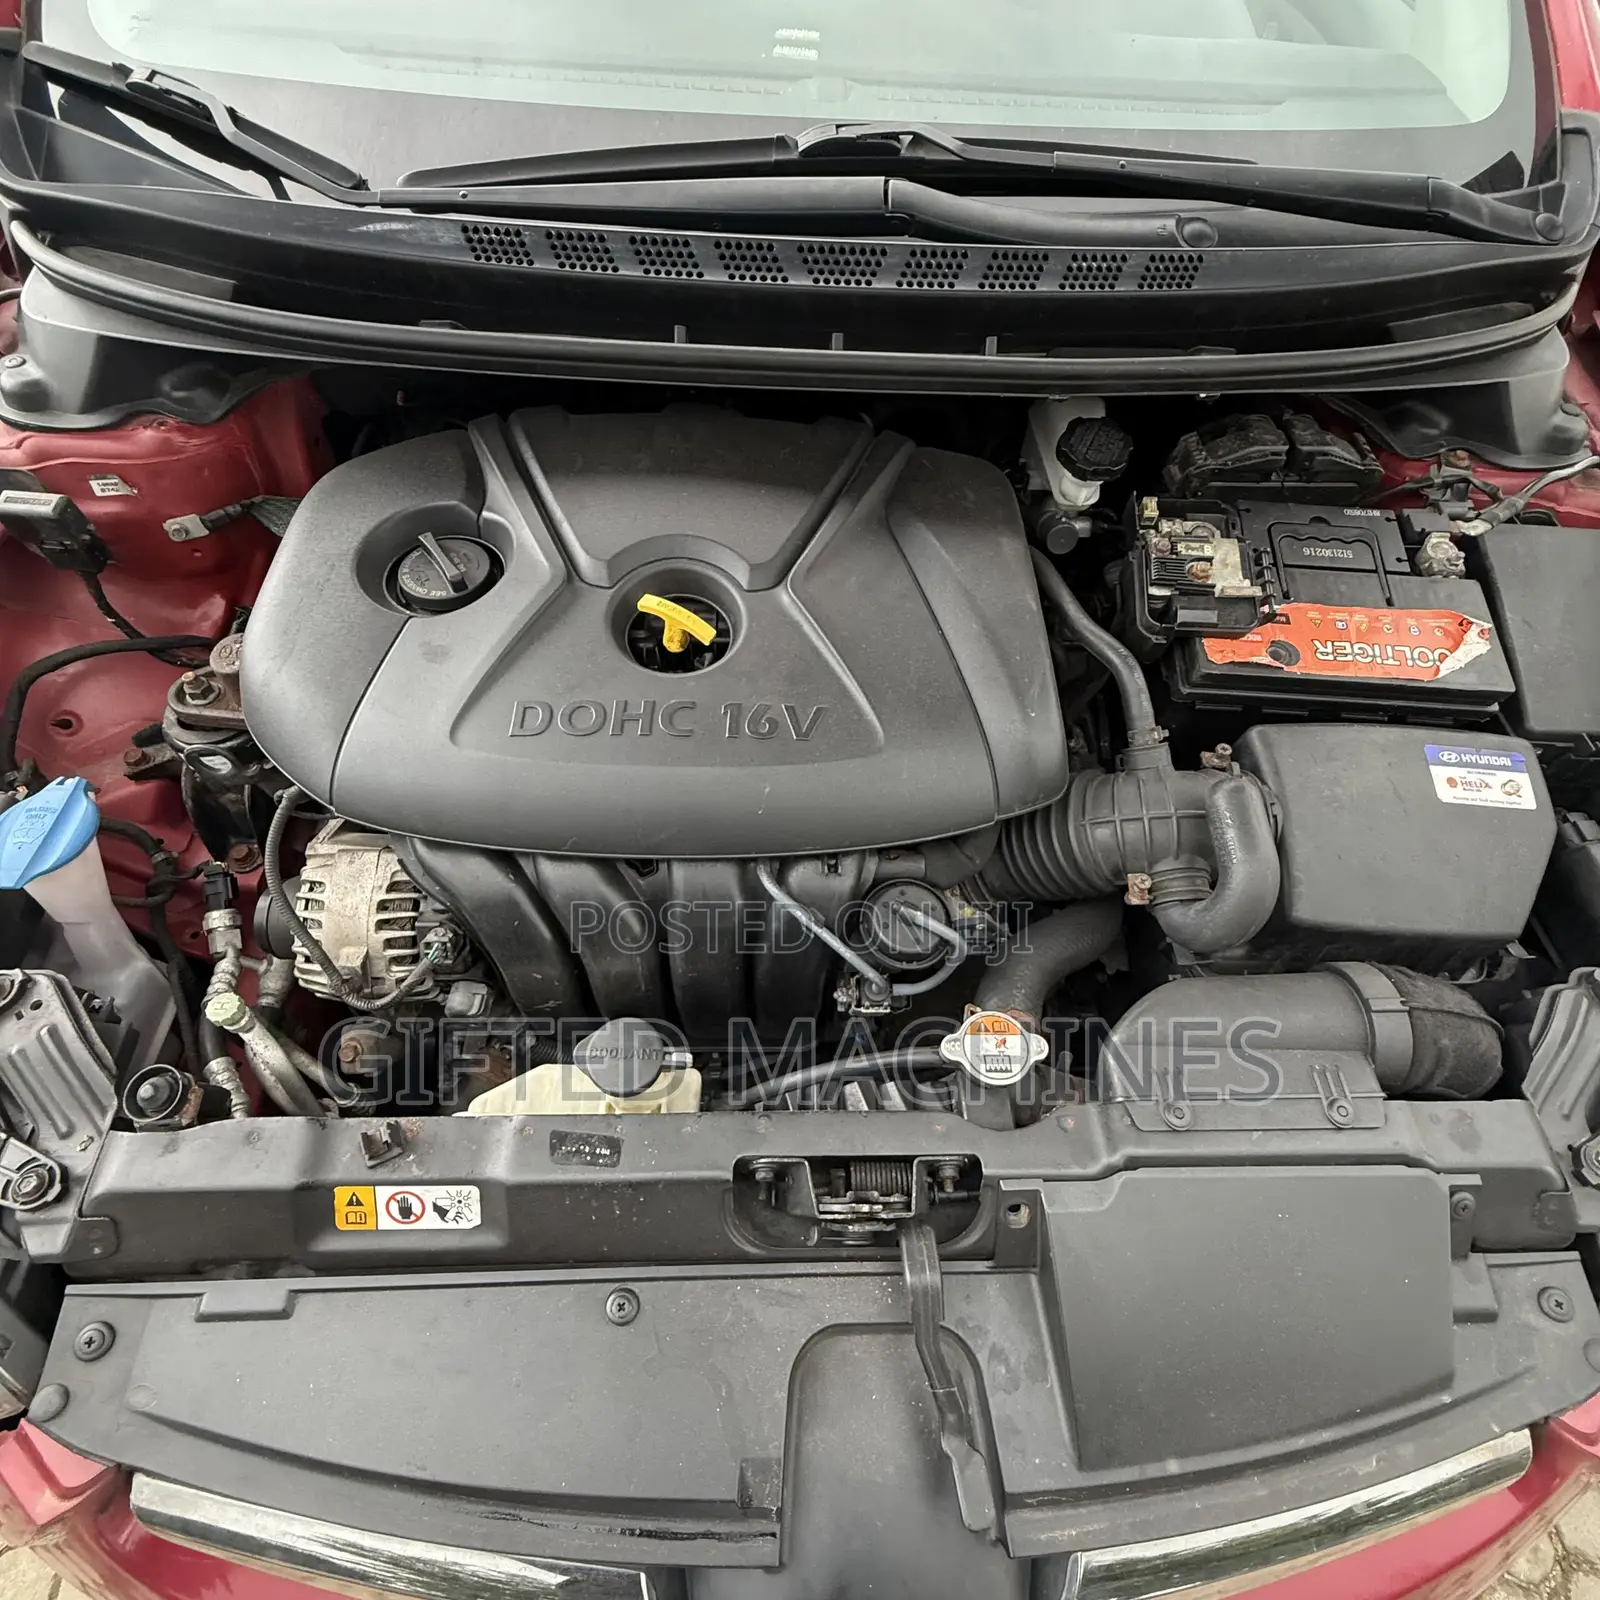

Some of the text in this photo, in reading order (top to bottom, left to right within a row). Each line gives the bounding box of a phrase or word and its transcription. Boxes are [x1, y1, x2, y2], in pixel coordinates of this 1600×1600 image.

[1302, 546, 1353, 560] 512130216
[508, 699, 831, 741] DOHC 16V
[1461, 753, 1512, 766] HYUNDAI
[589, 1047, 661, 1061] COOLANT
